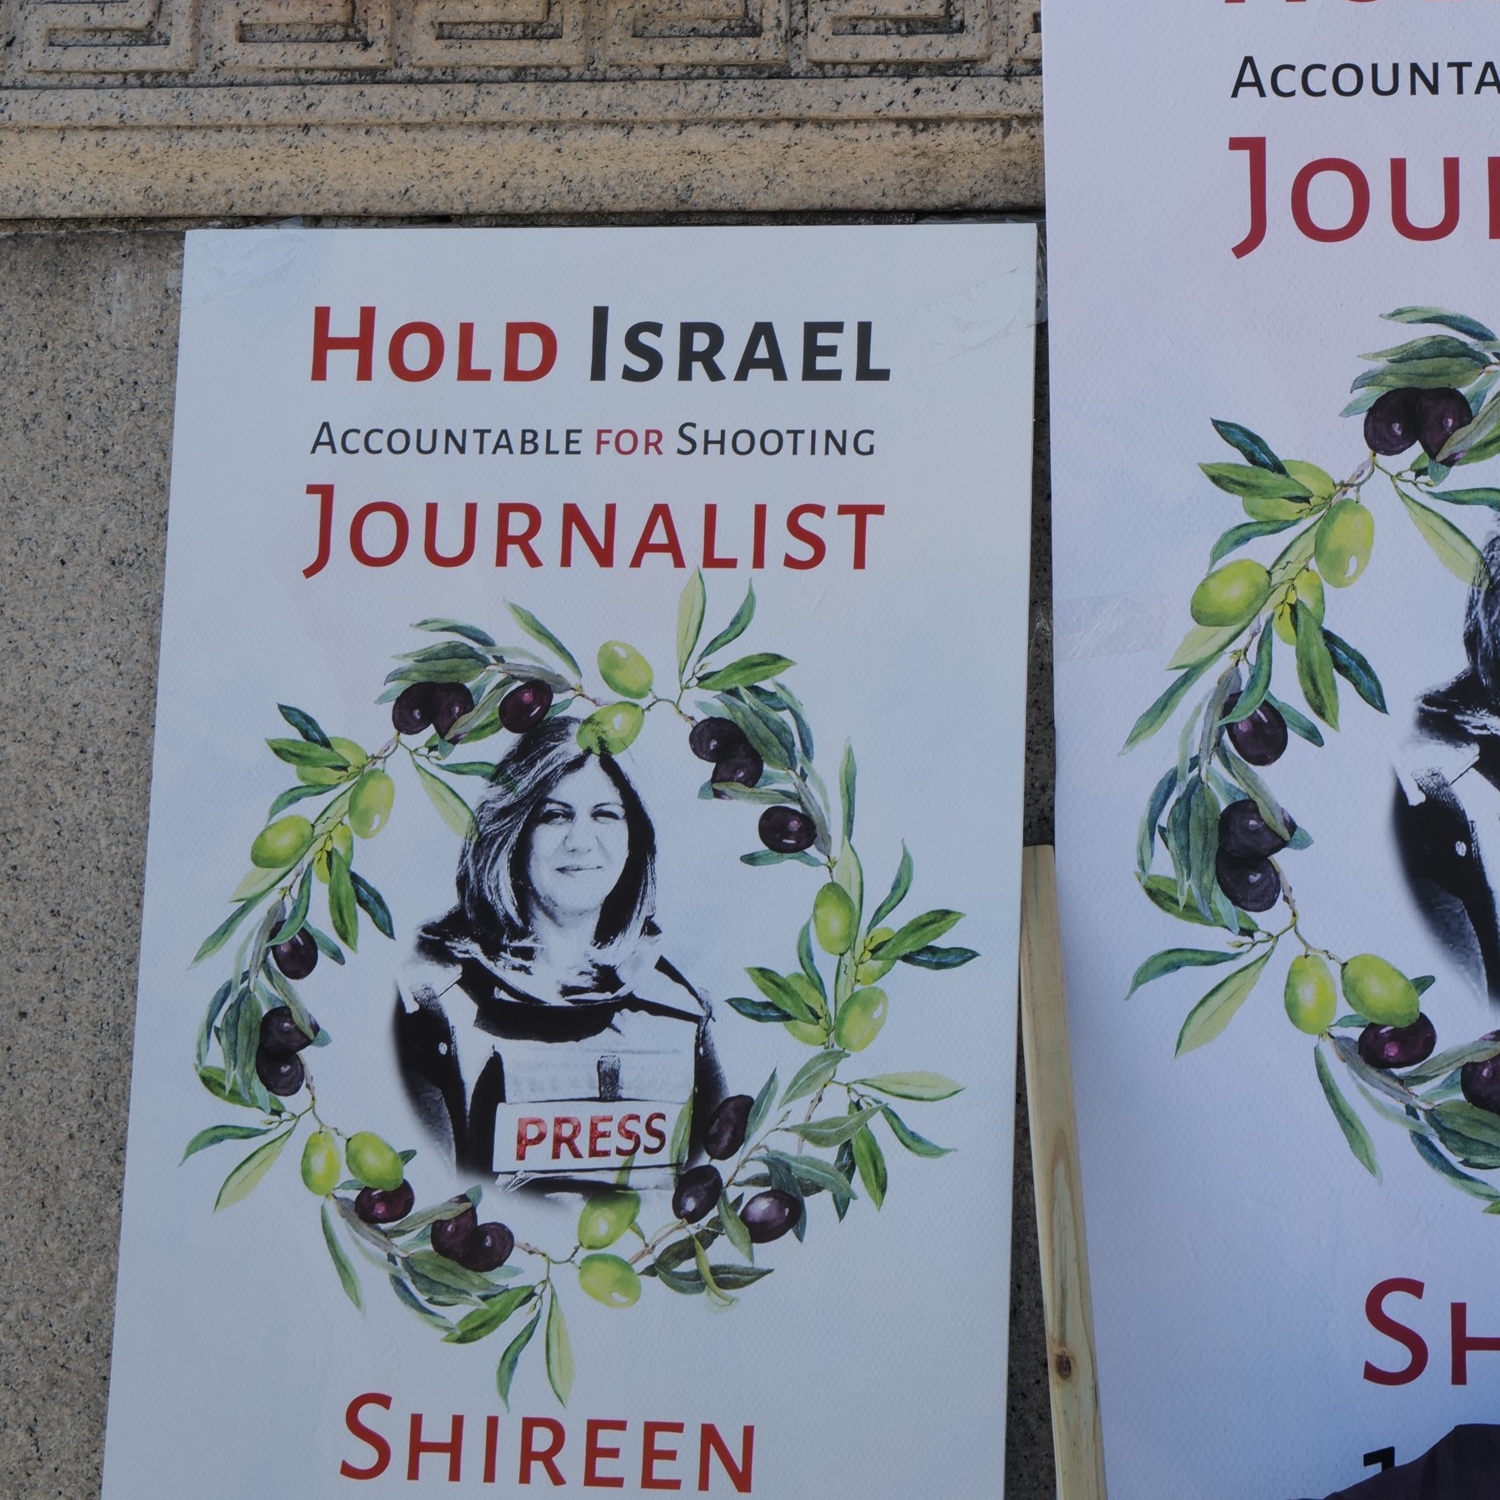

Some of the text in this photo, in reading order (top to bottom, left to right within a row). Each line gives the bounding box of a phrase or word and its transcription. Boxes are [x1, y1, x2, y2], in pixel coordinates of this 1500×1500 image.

[310, 305, 891, 382] HOLD ISRAEL
[310, 421, 876, 456] ACCOUNTABLE FOR SHOOTING
[302, 483, 885, 579] JOURNALIST
[515, 1111, 667, 1162] PRESS
[339, 1392, 756, 1494] SHIREEN
